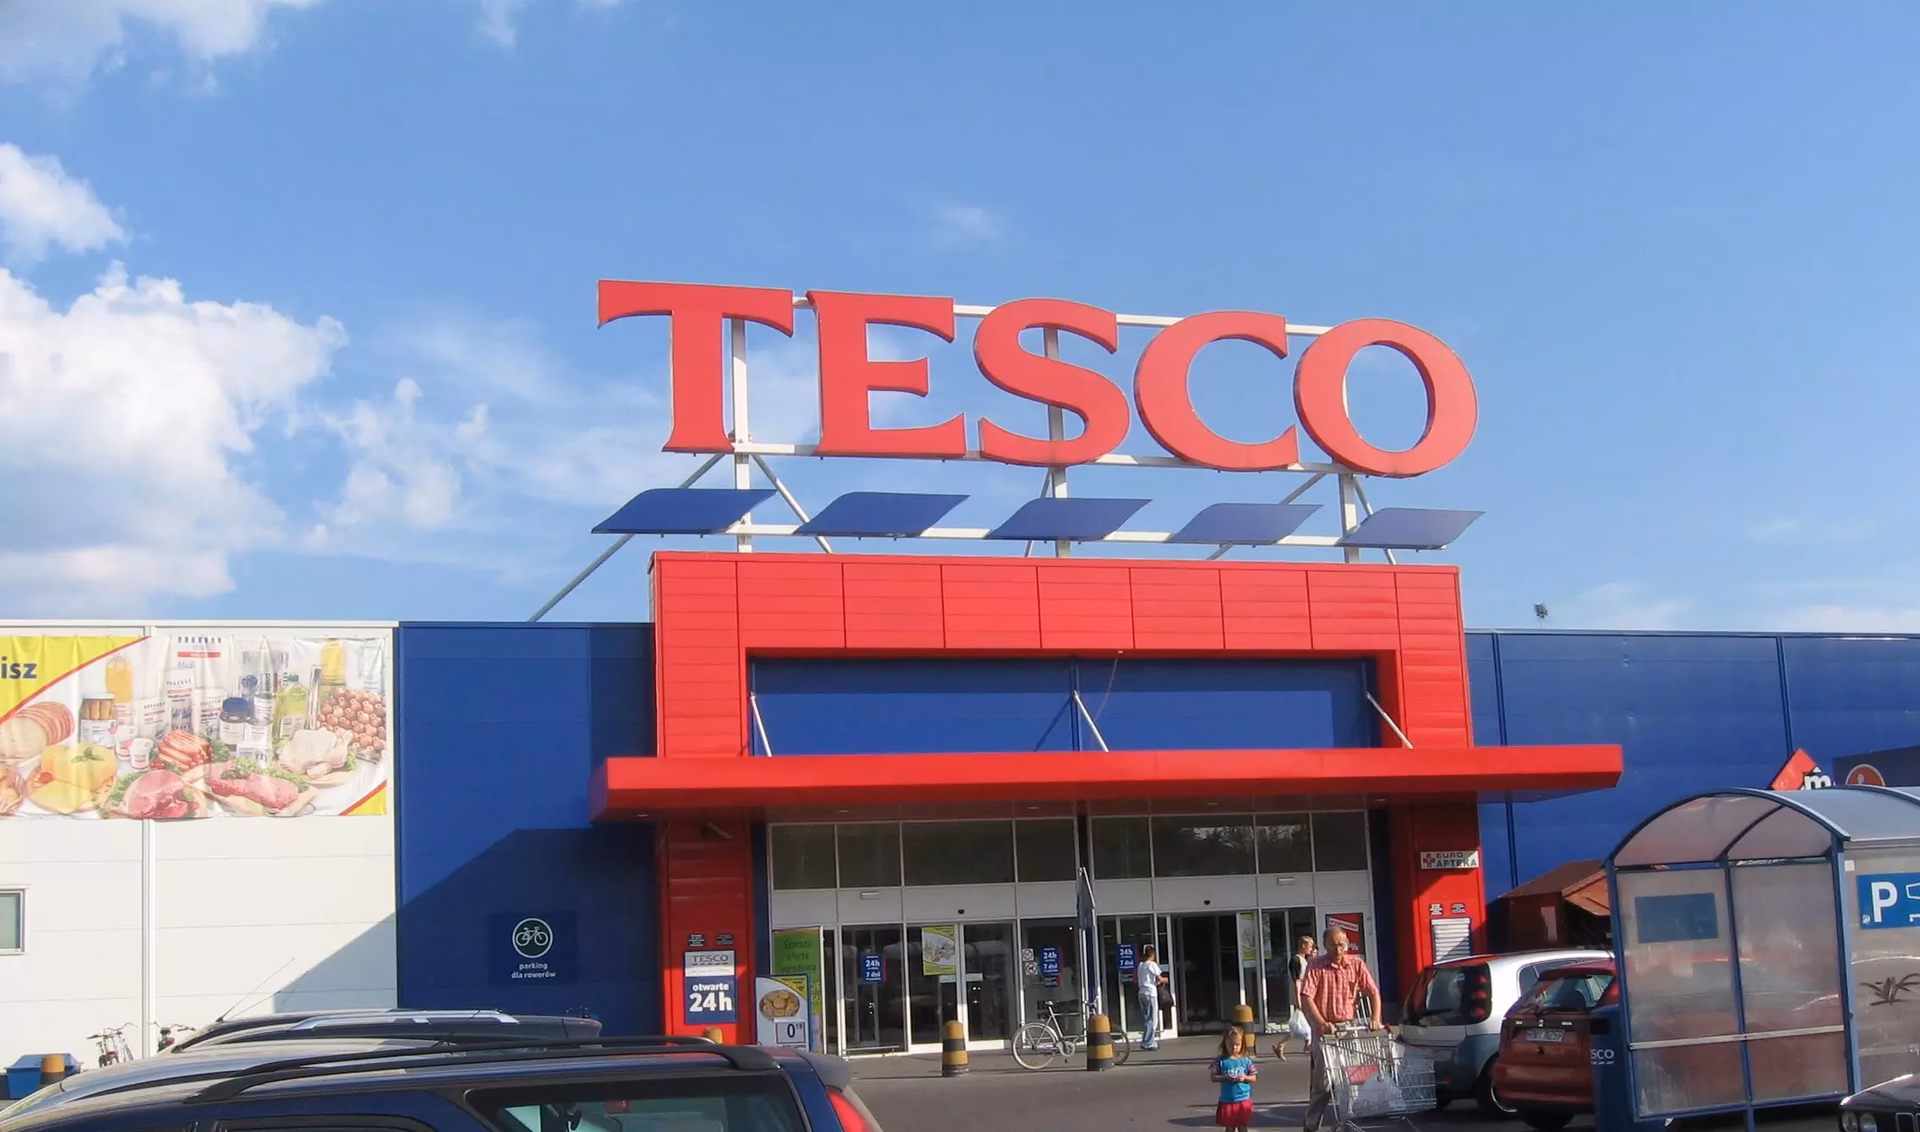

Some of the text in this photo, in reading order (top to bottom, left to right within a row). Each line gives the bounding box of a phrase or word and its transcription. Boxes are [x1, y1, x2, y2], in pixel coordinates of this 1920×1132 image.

[598, 279, 1478, 478] TESCO
[1, 656, 37, 679] isz
[1436, 859, 1477, 868] APTEKA
[1871, 881, 1898, 922] P
[691, 954, 729, 962] TESCO
[519, 962, 548, 970] parking
[524, 970, 556, 978] rowerów
[692, 983, 730, 991] otwarte
[689, 991, 733, 1012] 24h
